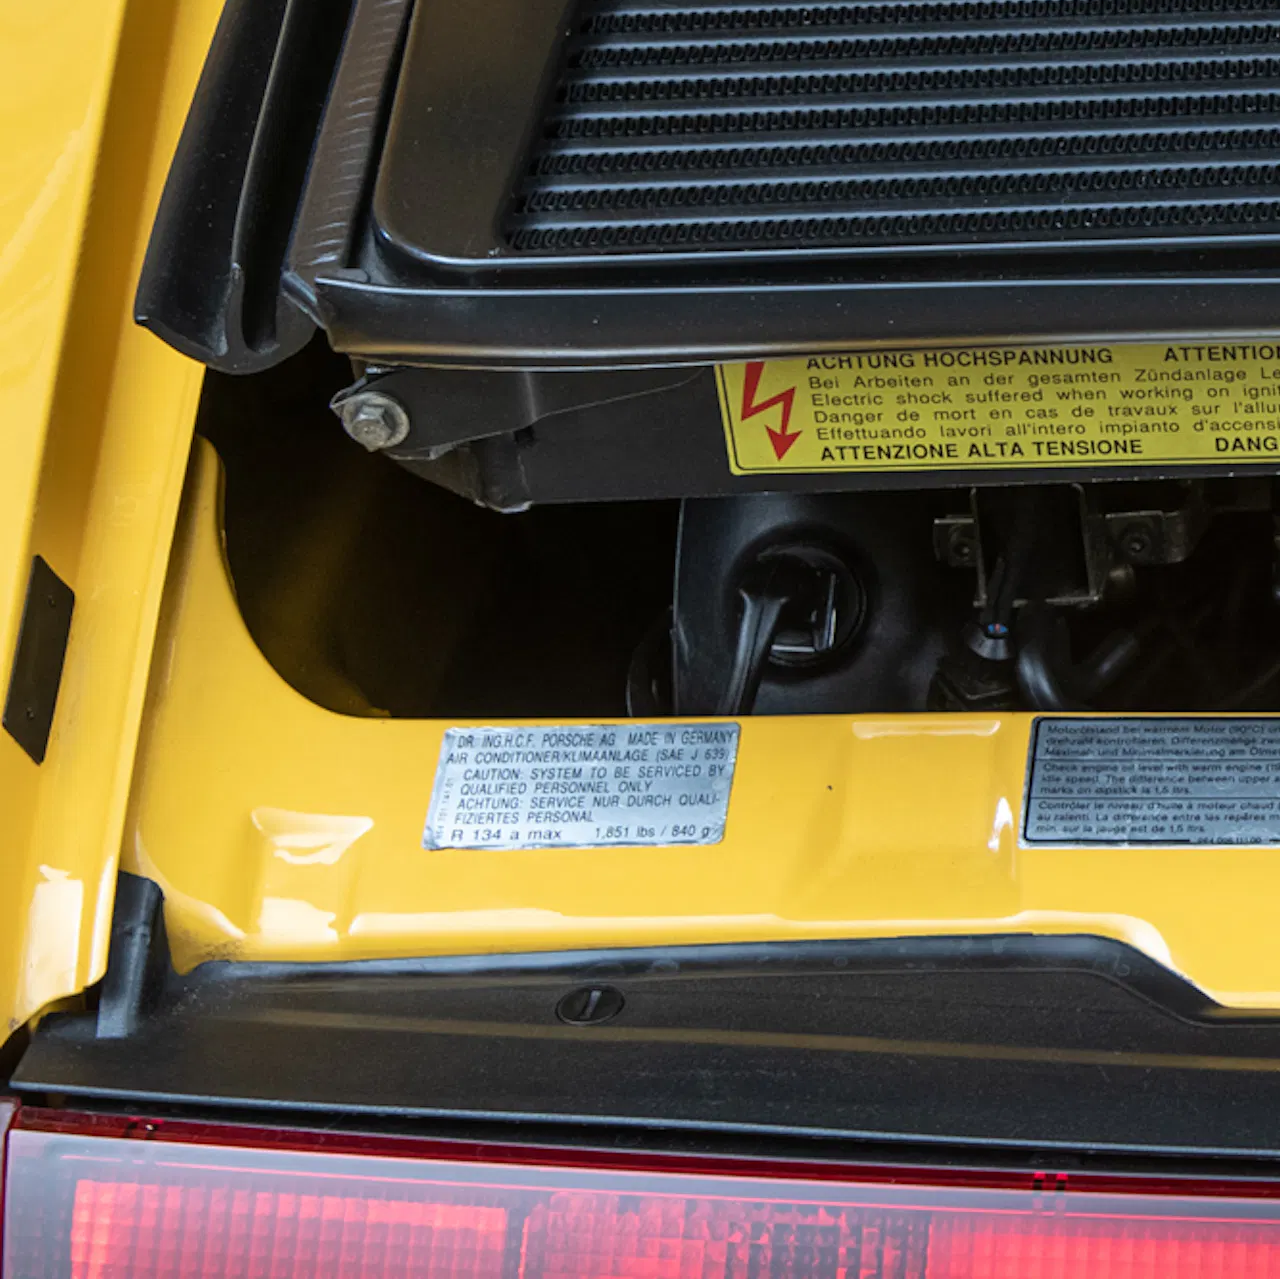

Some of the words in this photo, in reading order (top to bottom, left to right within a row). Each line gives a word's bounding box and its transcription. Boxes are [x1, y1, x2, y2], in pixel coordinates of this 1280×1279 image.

[807, 354, 914, 370] ACHTUNG
[923, 348, 1113, 368] HOCHSPANNUNG
[807, 376, 839, 389] Bei
[853, 375, 933, 389] Arbeiten
[947, 377, 970, 387] an
[982, 373, 1014, 386] der
[1026, 371, 1121, 389] gesamten
[1134, 369, 1247, 387] Zündanlage
[809, 393, 883, 405] Electric
[895, 391, 952, 404] shock
[965, 390, 1043, 403] suffered
[1055, 388, 1107, 401] when
[1118, 386, 1193, 403] working
[1206, 389, 1229, 398] on
[813, 410, 883, 426] Danger
[896, 409, 920, 421] de
[932, 408, 976, 420] mort
[988, 410, 1012, 419] en
[1024, 410, 1058, 419] cas
[1070, 406, 1095, 418] de
[1107, 405, 1178, 417] travaux
[1190, 407, 1221, 416] sur
[815, 426, 926, 440] Effettuando
[939, 424, 991, 438] lavori
[1005, 422, 1086, 437] all'intero
[1099, 421, 1180, 439] impianto
[820, 444, 959, 461] ATTENZIONE
[967, 443, 1024, 459] ALTA
[1031, 440, 1143, 458] TENSIONE
[542, 733, 594, 747] PORSCHE
[600, 732, 616, 746] AG
[628, 732, 658, 745] MADE
[664, 731, 675, 745] IN
[681, 730, 734, 744] GERMANY
[446, 752, 469, 764] AIR
[690, 748, 698, 762] J
[529, 768, 582, 780] SYSTEM
[586, 767, 607, 779] TO
[613, 767, 630, 779] BE
[637, 766, 702, 778] SERVICED
[707, 765, 729, 778] BY
[459, 783, 527, 795] QUALIFIED
[532, 782, 610, 795] PERSONNEL
[617, 781, 653, 794] ONLY
[529, 797, 586, 809] SERVICE
[591, 796, 620, 808] NUR
[627, 796, 672, 808] DURCH
[454, 813, 520, 825] FIZIERTES
[526, 811, 594, 824] PERSONAL
[450, 830, 464, 841] R
[473, 830, 501, 841] 134
[509, 832, 519, 841] a
[527, 832, 562, 841] max
[635, 826, 655, 839] lbs
[671, 825, 697, 838] 840
